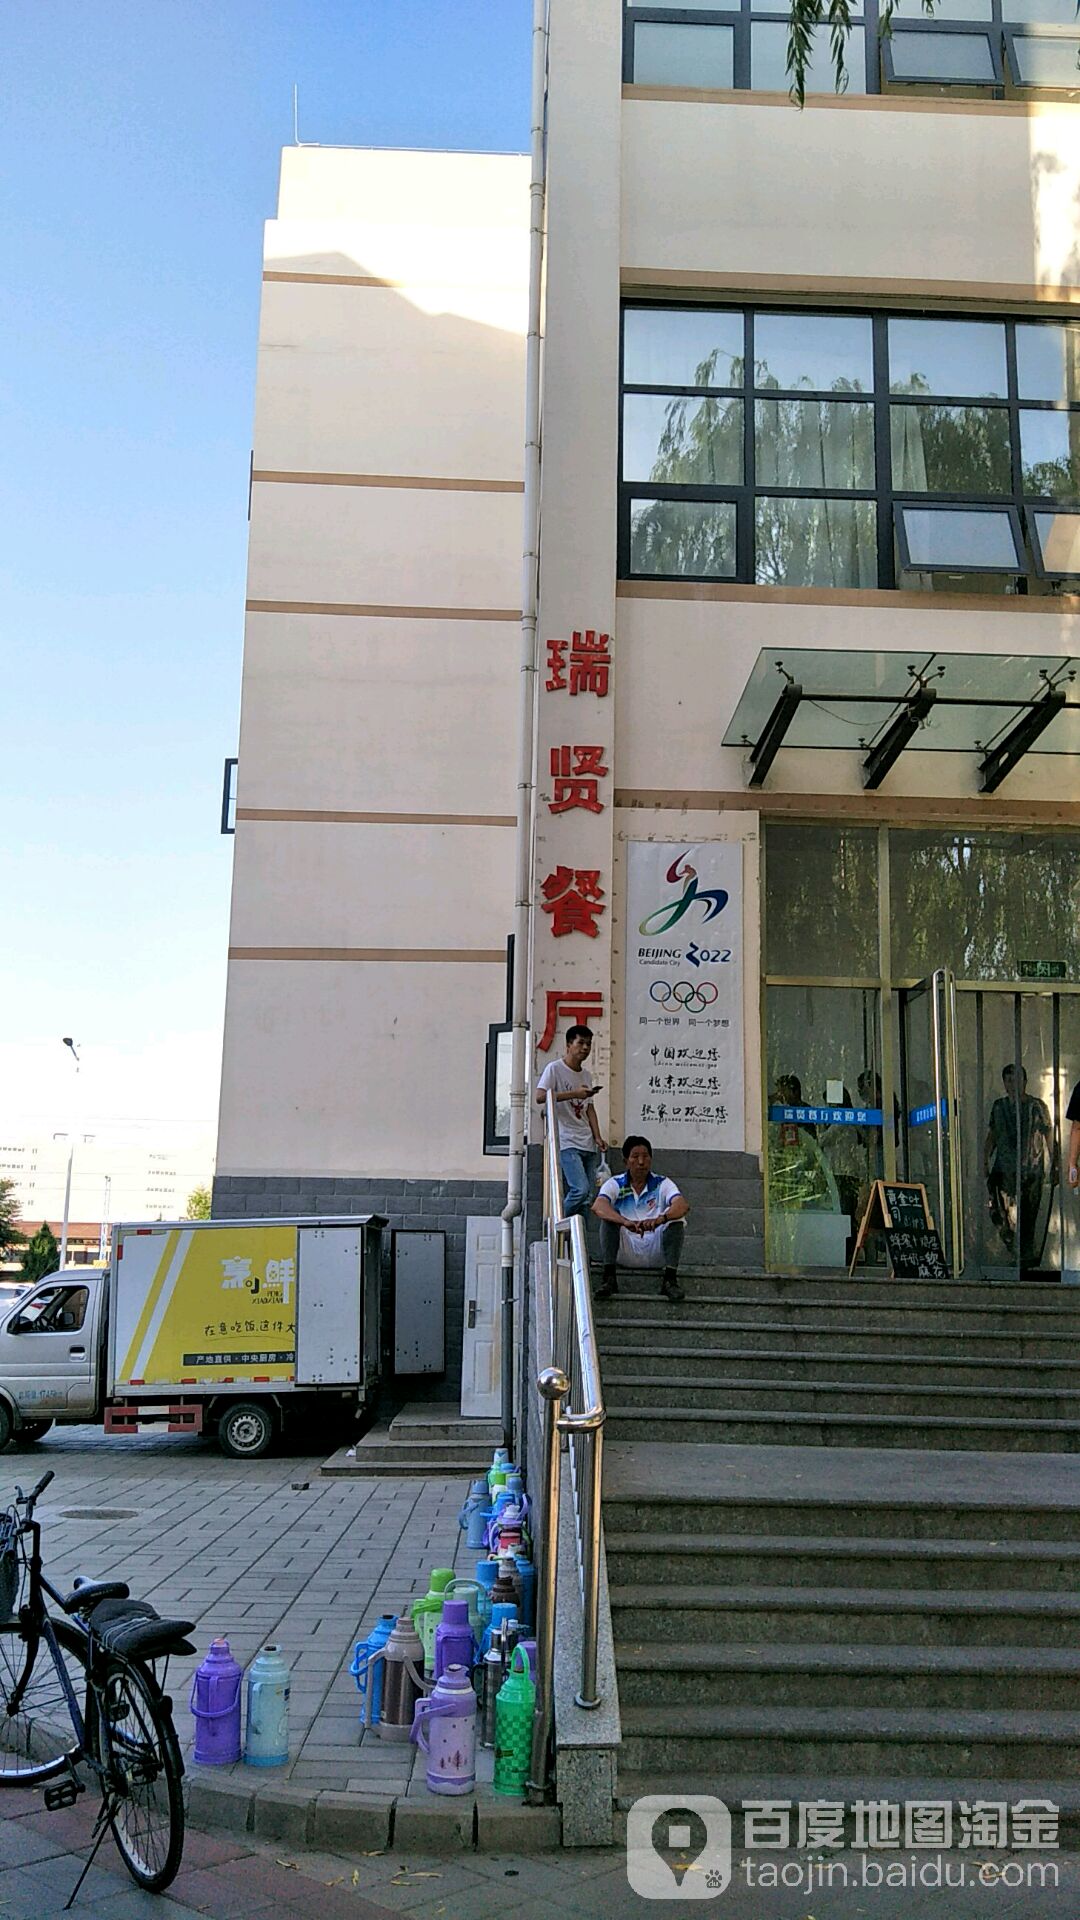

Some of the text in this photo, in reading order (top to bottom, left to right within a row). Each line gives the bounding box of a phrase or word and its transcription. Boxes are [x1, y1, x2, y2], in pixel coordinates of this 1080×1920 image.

[536, 630, 611, 1054] 瑞贤餐厅
[638, 942, 731, 968] BEIJING 2022
[669, 959, 680, 967] City
[639, 1016, 730, 1028] 同一个世界 同一个梦想
[650, 1045, 720, 1061] 中国欢迎您
[648, 1074, 721, 1090] 北京欢迎您
[640, 1102, 728, 1119] 张家口欢迎您
